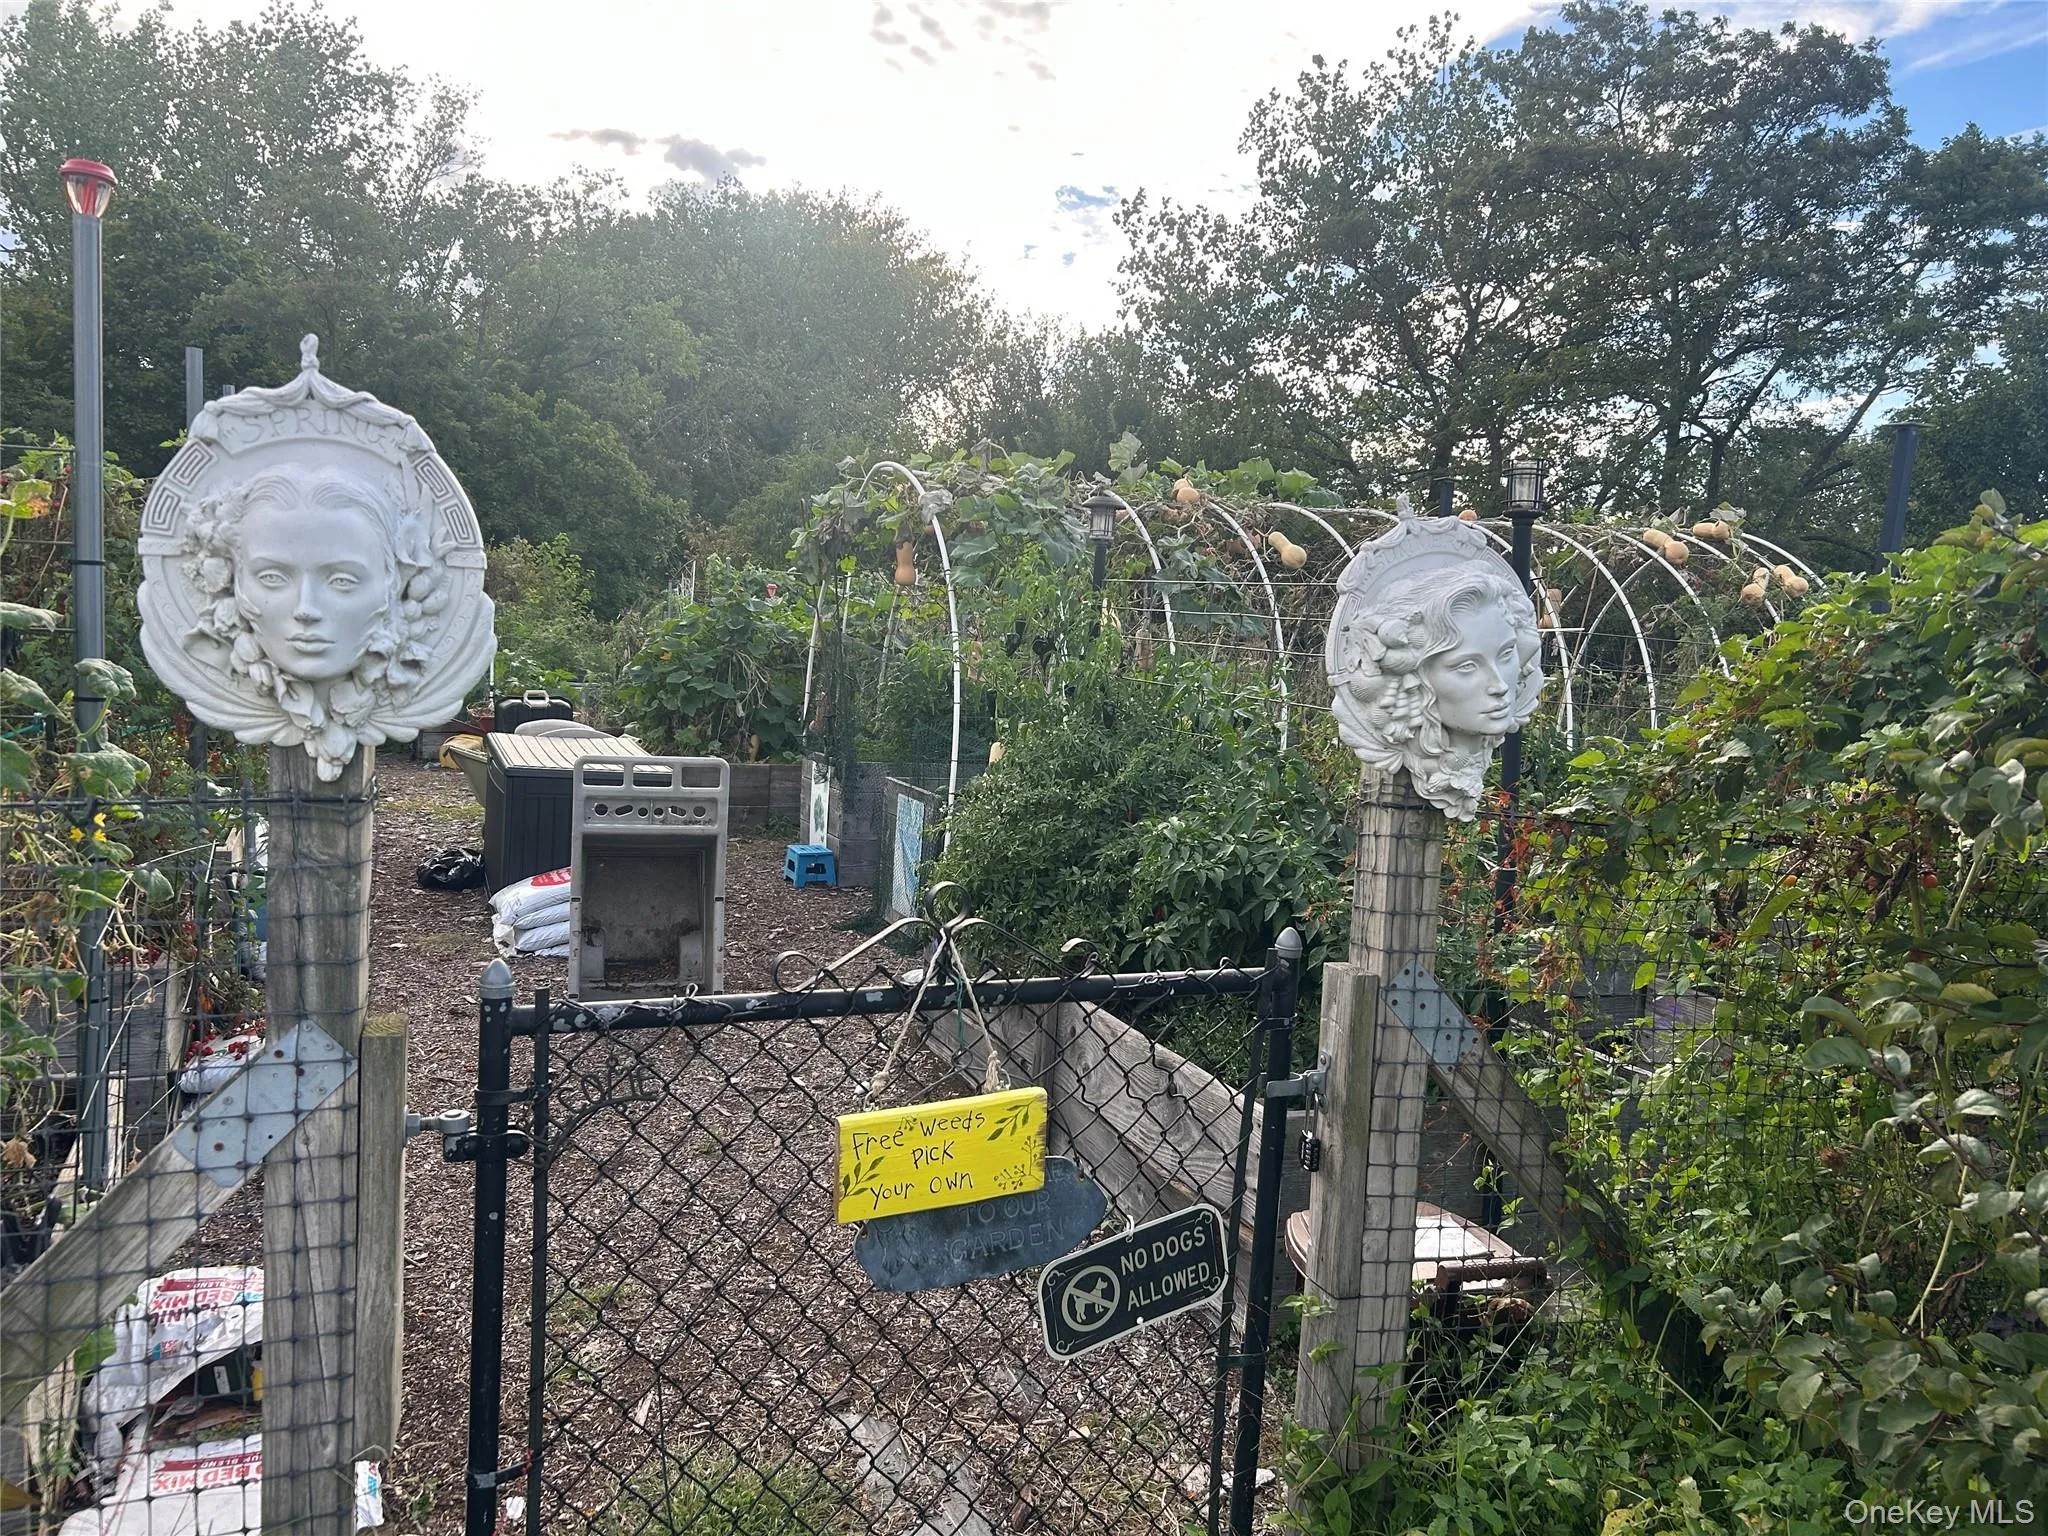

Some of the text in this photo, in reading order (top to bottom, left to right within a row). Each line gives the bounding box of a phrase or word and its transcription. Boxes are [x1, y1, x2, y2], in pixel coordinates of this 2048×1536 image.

[241, 406, 389, 453] SPRING
[852, 1129, 905, 1160] Free
[958, 1190, 1052, 1228] TO OUR
[950, 1218, 1065, 1262] GARDEN
[1120, 1226, 1206, 1276] NO DOGS
[151, 1289, 234, 1313] BED MIX
[1127, 1262, 1210, 1312] ALLOWED
[152, 1475, 196, 1492] MIX
[202, 1466, 250, 1484] BED
